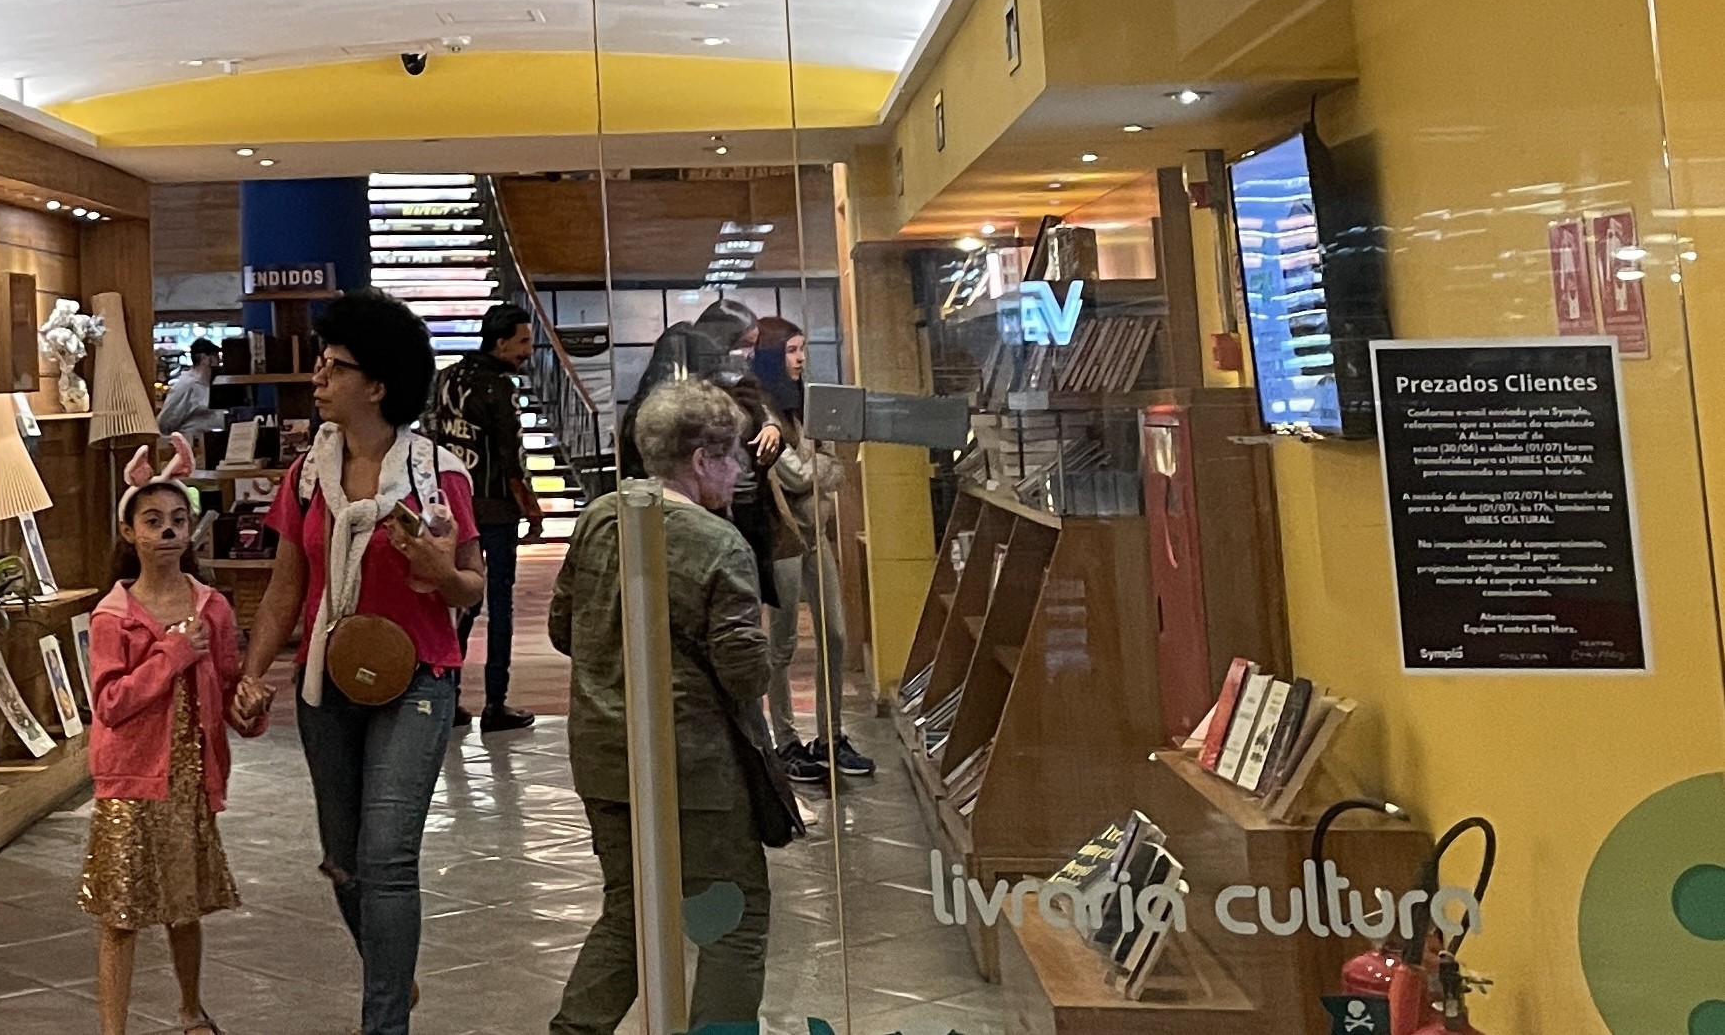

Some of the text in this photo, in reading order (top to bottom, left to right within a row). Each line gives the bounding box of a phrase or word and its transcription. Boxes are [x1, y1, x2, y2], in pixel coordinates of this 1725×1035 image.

[252, 269, 324, 286] ENDIDOS
[1396, 374, 1598, 393] Prezados Clientes
[930, 849, 1187, 934] livraria
[1216, 859, 1482, 940] cultura
